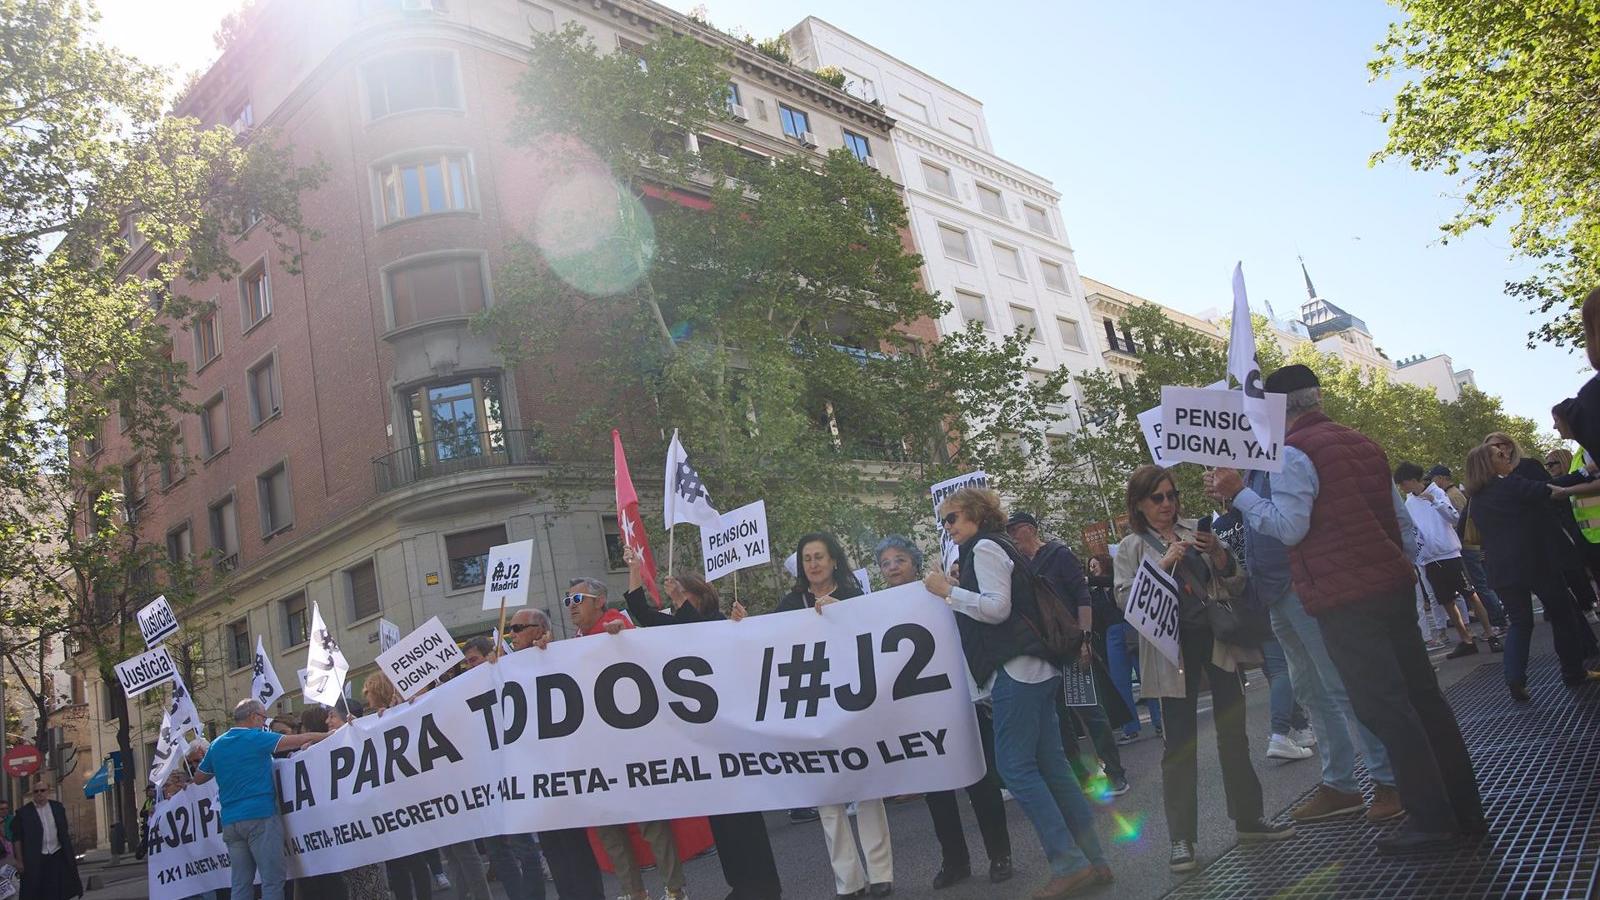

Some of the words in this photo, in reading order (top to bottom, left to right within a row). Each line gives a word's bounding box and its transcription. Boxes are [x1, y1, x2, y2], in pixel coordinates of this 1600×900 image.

[1175, 407, 1252, 432] PENSI
[1166, 432, 1237, 461] DIGNA,
[706, 547, 741, 573] DIGNA,
[744, 538, 765, 558] YA!
[708, 519, 758, 551] PENSIÓN
[490, 579, 519, 592] Madrid
[139, 598, 176, 639] Justicia!
[1128, 571, 1180, 645] sticia!
[120, 648, 174, 689] Justicia!
[390, 632, 443, 675] PENSIÓN
[396, 661, 440, 692] DIGNA,
[435, 643, 458, 663] YA!
[329, 712, 464, 801] PARA
[465, 655, 719, 751] TODOS
[755, 622, 952, 722] /#J2
[157, 865, 182, 885] 1X1
[333, 820, 373, 846] REAL
[371, 794, 459, 835] DECRETO
[532, 766, 618, 798] RETA-
[626, 755, 712, 788] REAL
[718, 746, 869, 779] DECRETO
[876, 728, 948, 765] LEY
